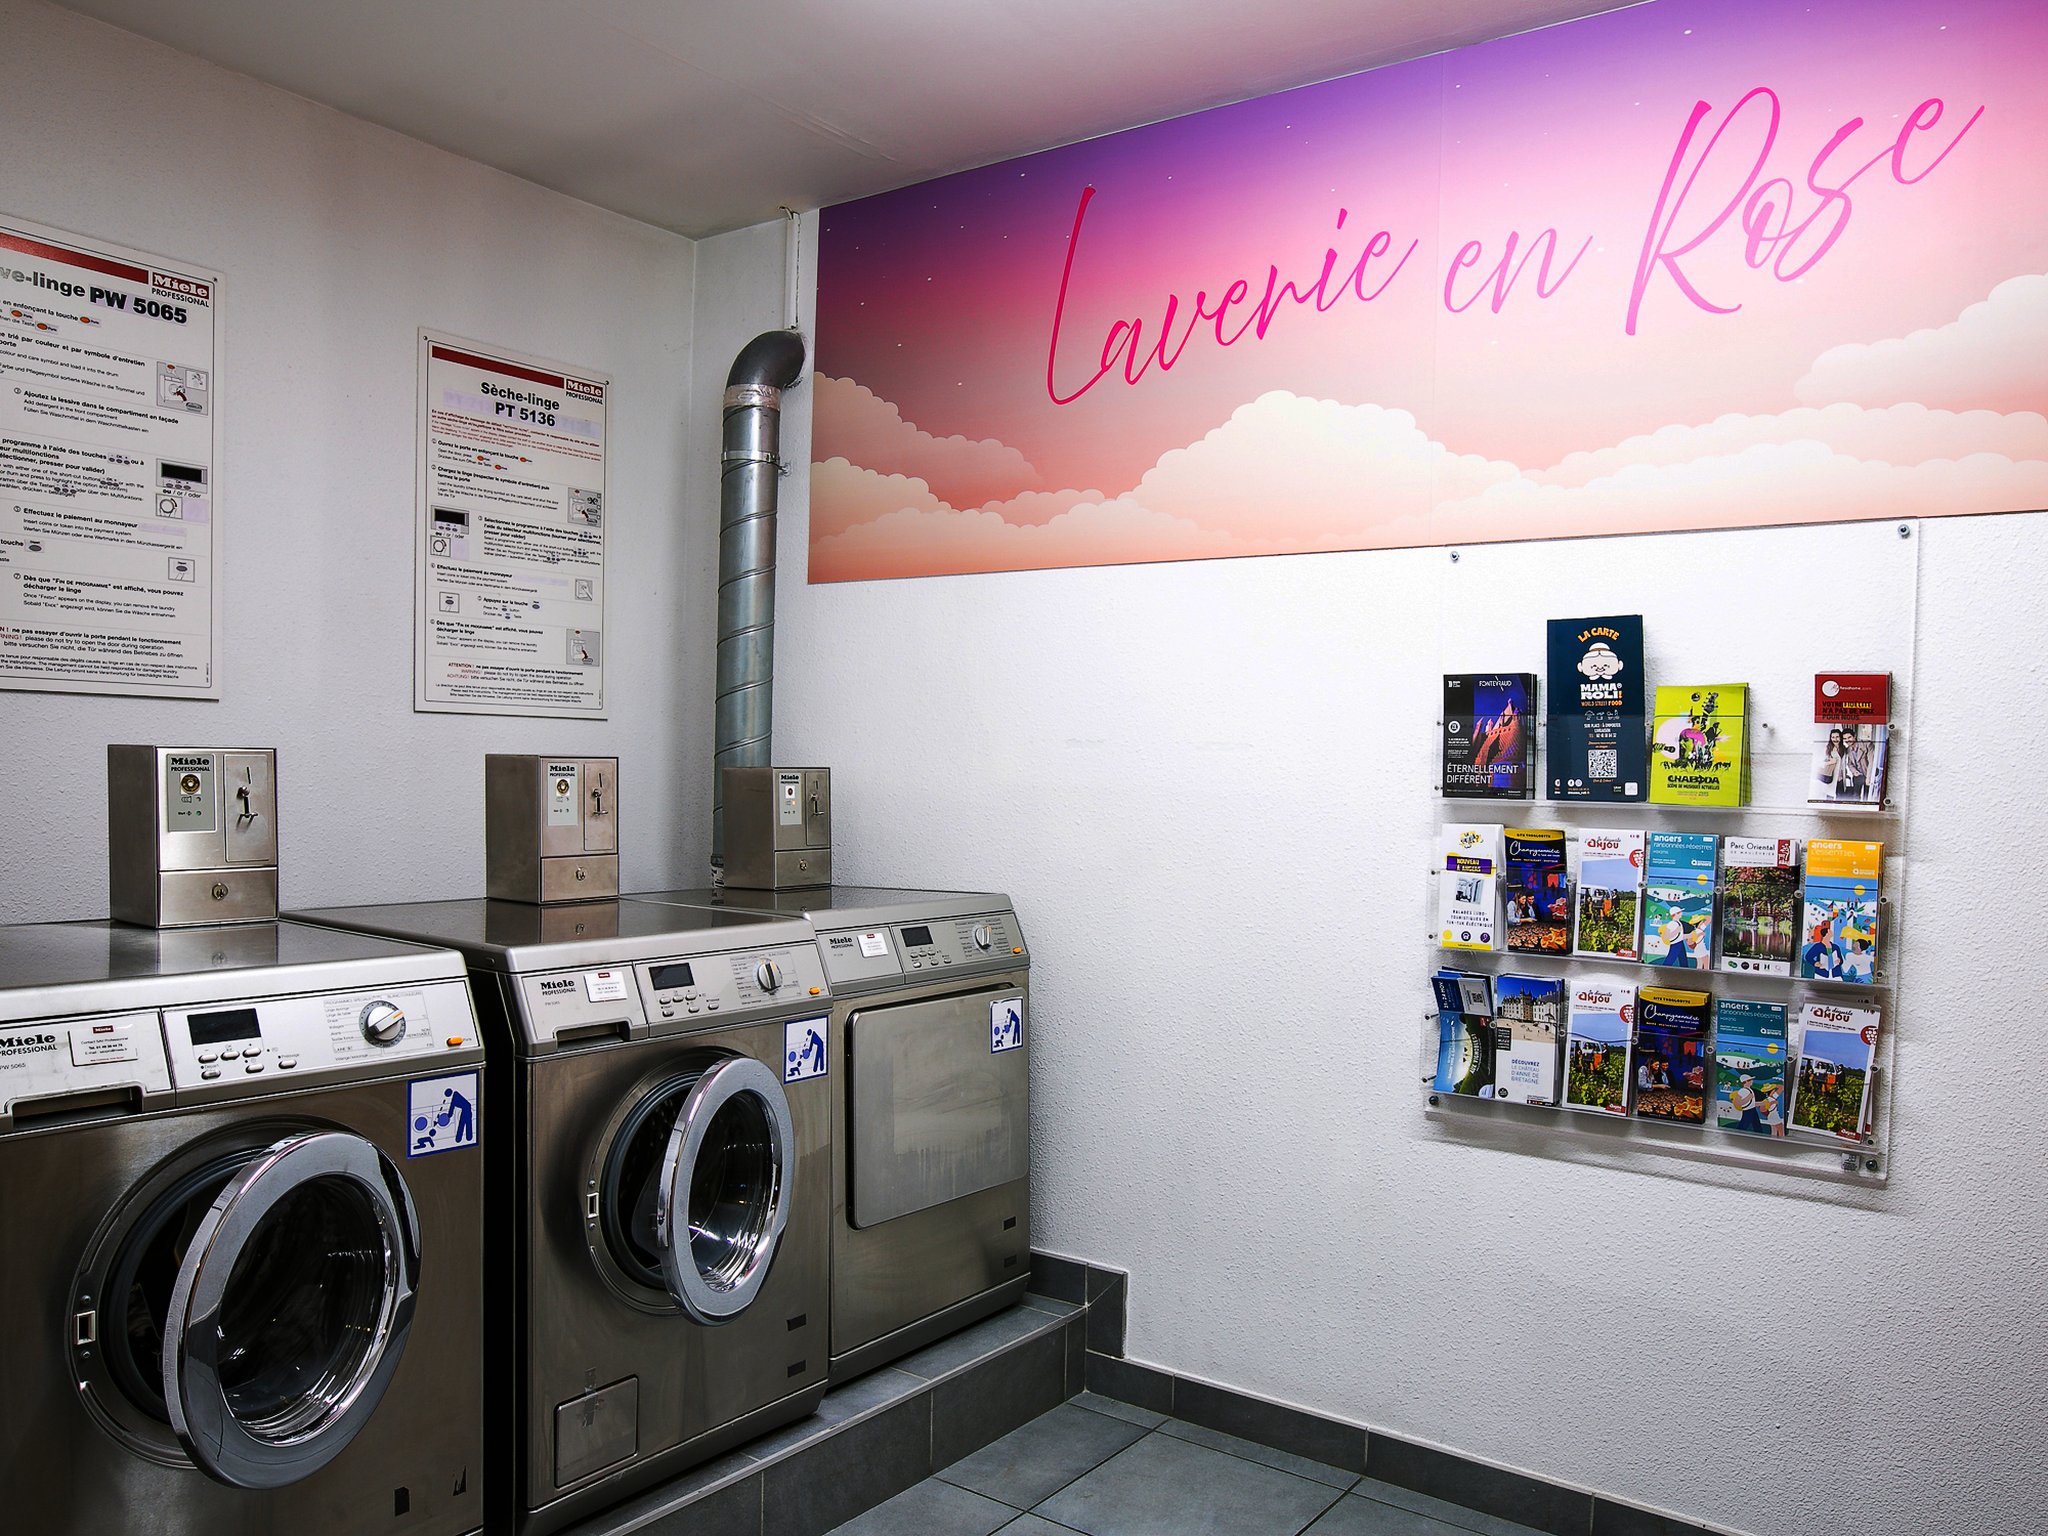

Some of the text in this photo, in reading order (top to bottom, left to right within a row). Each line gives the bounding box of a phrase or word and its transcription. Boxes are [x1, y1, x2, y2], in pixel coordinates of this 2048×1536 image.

[1046, 87, 1985, 405] Laverie en Rose
[153, 274, 208, 297] Miele
[90, 286, 127, 309] PW
[133, 297, 187, 323] 5065
[152, 288, 209, 308] PROFESSIONAL
[13, 301, 47, 314] enfonçant
[56, 311, 78, 321] touche
[35, 339, 60, 348] couleur
[84, 349, 110, 359] symbole
[567, 381, 602, 396] Miele
[481, 382, 560, 411] Sèche-linge
[565, 391, 603, 405] PROFESSIONAL
[24, 390, 49, 400] Ajoutez
[58, 397, 80, 405] lessive
[106, 406, 149, 419] compartiment
[496, 402, 556, 427] PT 5136
[2, 438, 41, 449] programme
[81, 450, 107, 459] touches
[12, 447, 60, 460] multifonctions
[39, 459, 64, 468] presser
[23, 507, 54, 517] Effectuez
[63, 514, 93, 522] paiement
[104, 520, 138, 528] monnayeur
[24, 583, 57, 591] décharger
[139, 637, 181, 645] fonctionnement
[1577, 627, 1620, 643] LA CARTE
[1581, 690, 1623, 700] ROLI!
[171, 757, 210, 765] Miele
[1447, 762, 1519, 774] ÉTERNELLEMENT
[1446, 773, 1492, 784] DIFFÉRENT
[1730, 841, 1776, 851] Parc Oriental
[540, 980, 575, 990] Miele
[542, 988, 576, 996] PROFESSIONAL
[0, 1034, 56, 1048] Miele
[0, 1044, 57, 1057] ROFESSIONAL
[1511, 1059, 1540, 1067] DÉCOUVREZ
